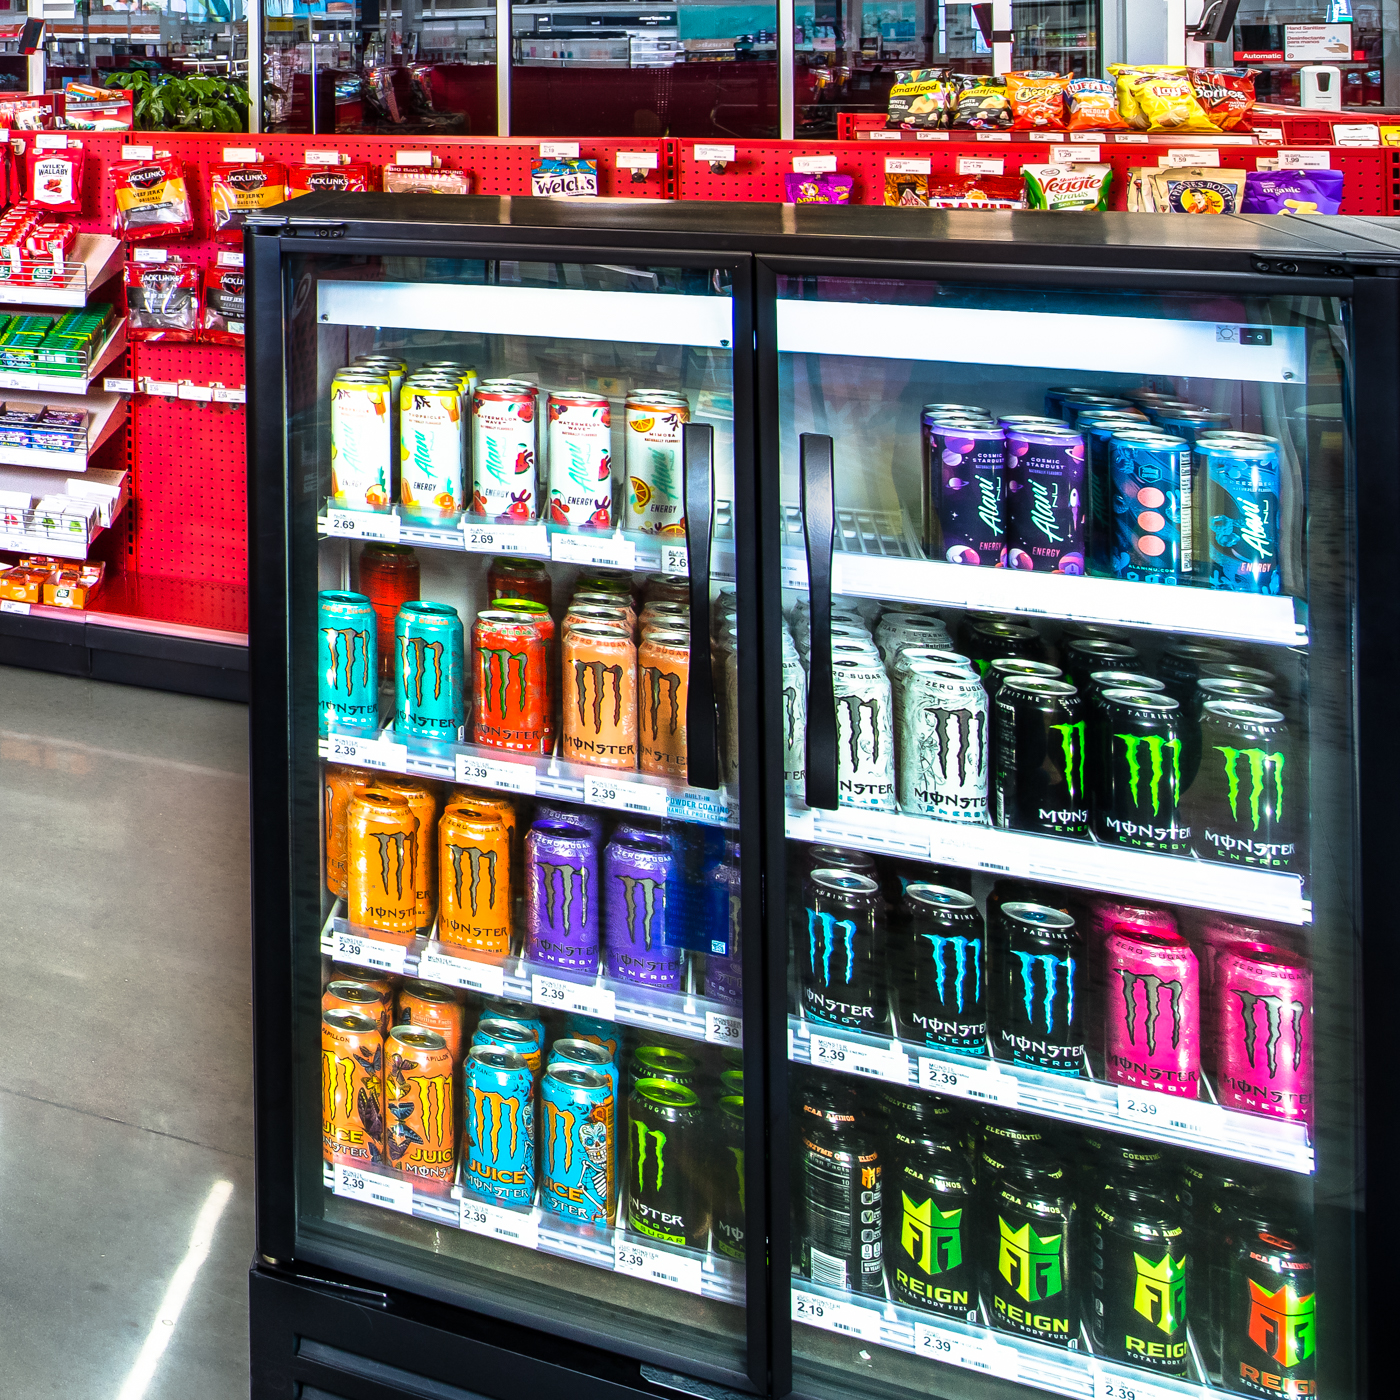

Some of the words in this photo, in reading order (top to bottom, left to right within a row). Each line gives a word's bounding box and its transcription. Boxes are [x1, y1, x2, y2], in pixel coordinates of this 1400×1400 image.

[890, 82, 938, 95] Smartfood
[959, 86, 1006, 98] Smartfood
[1015, 84, 1063, 102] Cheetos
[1066, 81, 1114, 96] RUFFLES
[1154, 84, 1192, 97] Lay's
[1194, 86, 1245, 100] Doritos
[38, 168, 69, 176] WALLABY
[127, 173, 144, 183] JACK
[144, 169, 166, 180] LINK'S
[227, 174, 244, 182] JACK
[244, 173, 267, 182] LINK'S
[389, 167, 401, 175] BIG
[307, 177, 324, 186] JACK
[324, 178, 349, 187] LINK'S
[535, 176, 595, 196] Welch's
[1038, 177, 1102, 194] Veggie
[132, 190, 147, 199] BEEF
[147, 188, 164, 198] JERKY
[1053, 191, 1089, 201] Straws
[1262, 184, 1301, 195] organic
[796, 194, 830, 204] Annie's
[565, 440, 595, 494] Alani
[1026, 462, 1065, 470] STARDUST
[413, 481, 437, 492] ENERGY
[485, 488, 510, 499] ENERGY
[567, 496, 594, 507] ENERGY
[974, 474, 1004, 537] Alani
[650, 504, 677, 515] ENERGY
[1027, 478, 1064, 544] Alani
[333, 520, 355, 531] 2.69
[1236, 496, 1273, 560] Alani
[470, 534, 494, 546] 2.69
[979, 542, 1002, 551] ENERGY
[1032, 546, 1061, 558] ENERGY
[1128, 564, 1175, 573] ALANINU.COM
[1127, 708, 1174, 722] TAURINE
[476, 722, 540, 741] MONSTER
[1226, 719, 1276, 733] TAURINE
[479, 736, 534, 749] ENERGY
[563, 733, 635, 756] MONSTER
[334, 744, 356, 756] 2.39
[571, 750, 627, 764] ENERGY
[464, 766, 488, 778] 2.39
[591, 787, 616, 800] 2.39
[684, 792, 711, 801] BUILT-IN
[665, 795, 694, 807] POWDER
[695, 802, 730, 814] COATING
[1105, 816, 1192, 843] MONSTER
[1119, 835, 1187, 852] ENERGY
[1203, 828, 1296, 857] MONSTER
[1217, 848, 1290, 867] ENERGY
[932, 909, 974, 921] TAURINE
[441, 918, 508, 937] MONSTER
[1022, 926, 1069, 941] TAURINE
[448, 932, 501, 948] ENERGY
[339, 943, 361, 955] 2.39
[538, 952, 593, 966] ENERGY
[618, 966, 675, 980] ENERGY
[540, 987, 565, 1000] 2.39
[713, 1024, 740, 1038] 2.39
[1001, 1030, 1086, 1059] MONSTER
[818, 1047, 846, 1062] 2.39
[1013, 1053, 1080, 1071] ENERGY
[1107, 1053, 1199, 1084] MONSTER
[928, 1070, 958, 1086] 2.39
[1116, 1070, 1189, 1095] ENERGY
[1126, 1099, 1158, 1116] 2.39
[1233, 1092, 1310, 1117] ENERGY
[468, 1159, 526, 1185] JUICE
[904, 1166, 926, 1182] BCAA
[928, 1175, 962, 1190] AMINOS
[342, 1175, 365, 1190] 2.39
[466, 1174, 530, 1199] MONSTER
[464, 1209, 487, 1224] 2.39
[618, 1251, 643, 1267] 2.39
[896, 1268, 969, 1305] REIGN
[797, 1301, 824, 1318] 2.19
[994, 1295, 1069, 1333] REIGN
[923, 1336, 952, 1352] 2.39
[1104, 1384, 1136, 1400] 2.39
